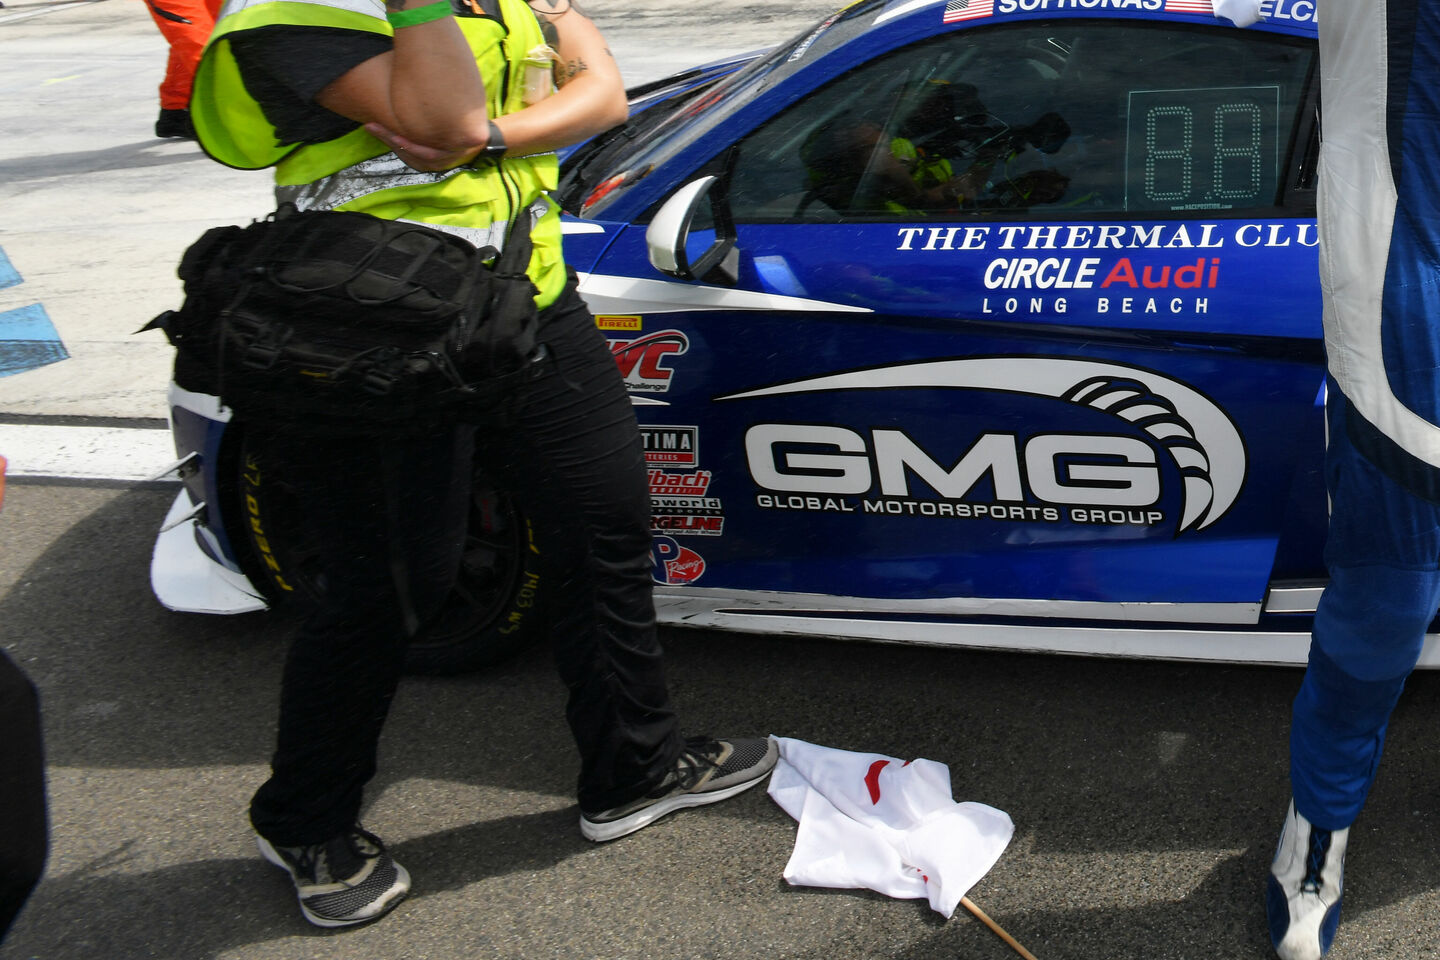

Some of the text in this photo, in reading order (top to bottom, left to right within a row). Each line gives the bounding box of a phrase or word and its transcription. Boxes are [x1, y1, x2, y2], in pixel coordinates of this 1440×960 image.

[897, 223, 1320, 250] THE THERMAL CLU
[983, 258, 1219, 289] CIRCLE Audi
[983, 298, 1208, 313] LONG BEACH
[599, 317, 638, 328] PIRELLI
[641, 433, 691, 449] TIMA
[745, 423, 1161, 506] GMG
[648, 470, 710, 486] ibach
[756, 494, 1164, 525] GLOBAL MOTORSPORTS GROUP
[668, 559, 701, 577] Racing
